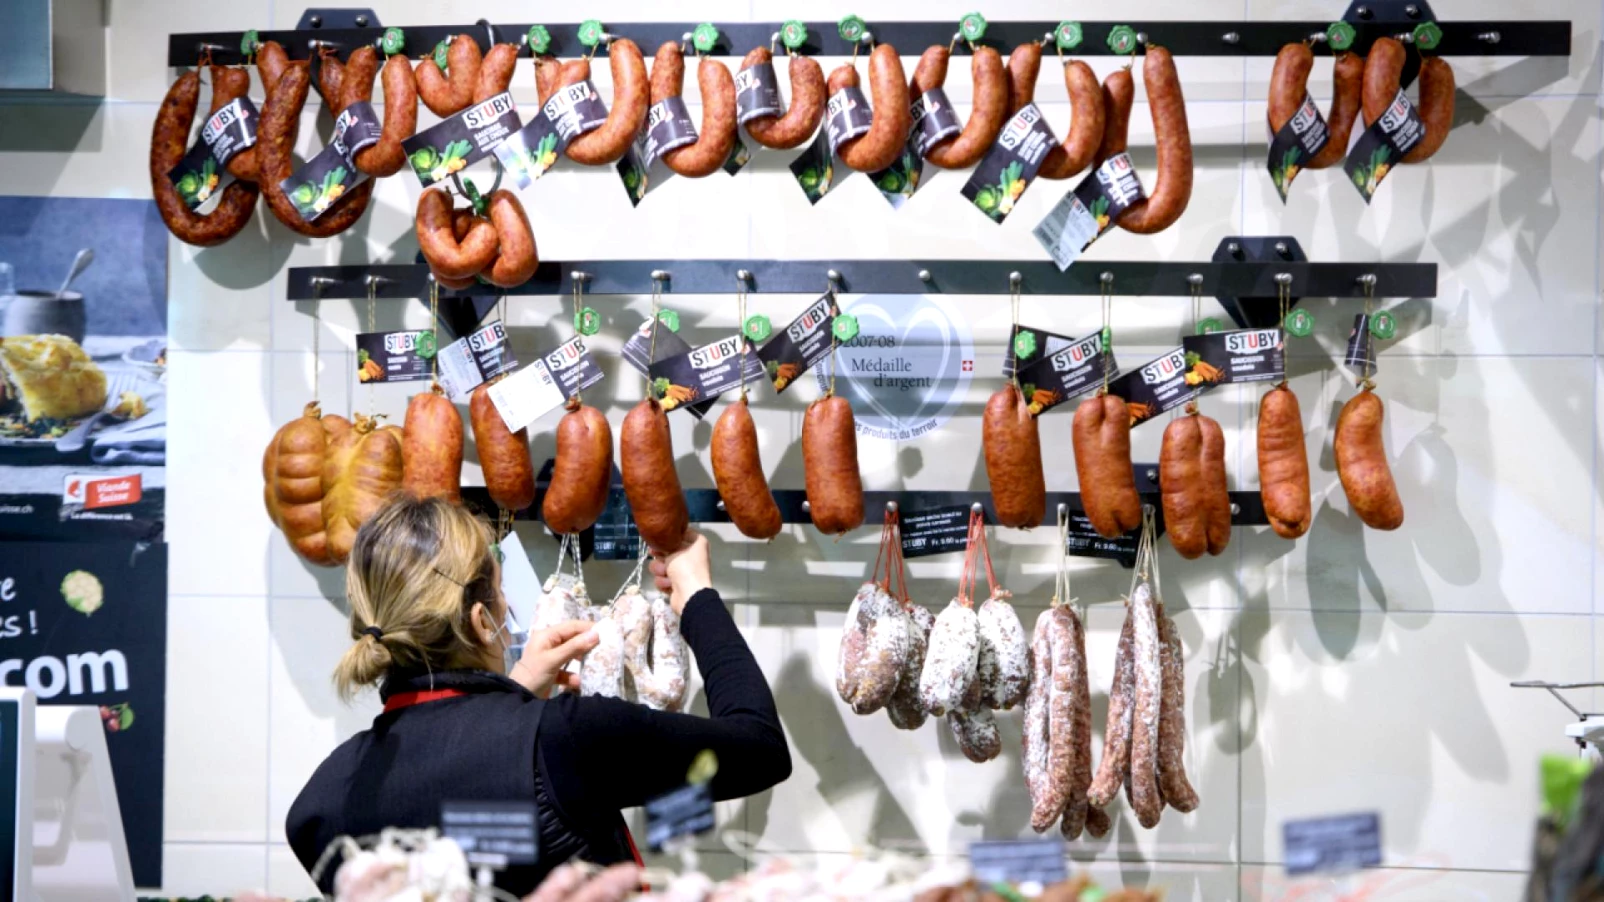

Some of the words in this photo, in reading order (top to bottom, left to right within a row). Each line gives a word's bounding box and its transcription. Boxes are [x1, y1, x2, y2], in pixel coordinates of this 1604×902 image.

[203, 104, 237, 143] STUBY
[466, 94, 510, 126] STUBY
[1002, 106, 1038, 147] STUBY
[789, 303, 828, 341] STUBY
[692, 338, 739, 367] STUBY
[1054, 338, 1098, 369] STUBY
[1229, 331, 1276, 350] STUBY
[851, 357, 913, 372] Médaille
[873, 373, 932, 391] d'argent
[899, 429, 911, 440] du
[911, 417, 938, 437] terroir
